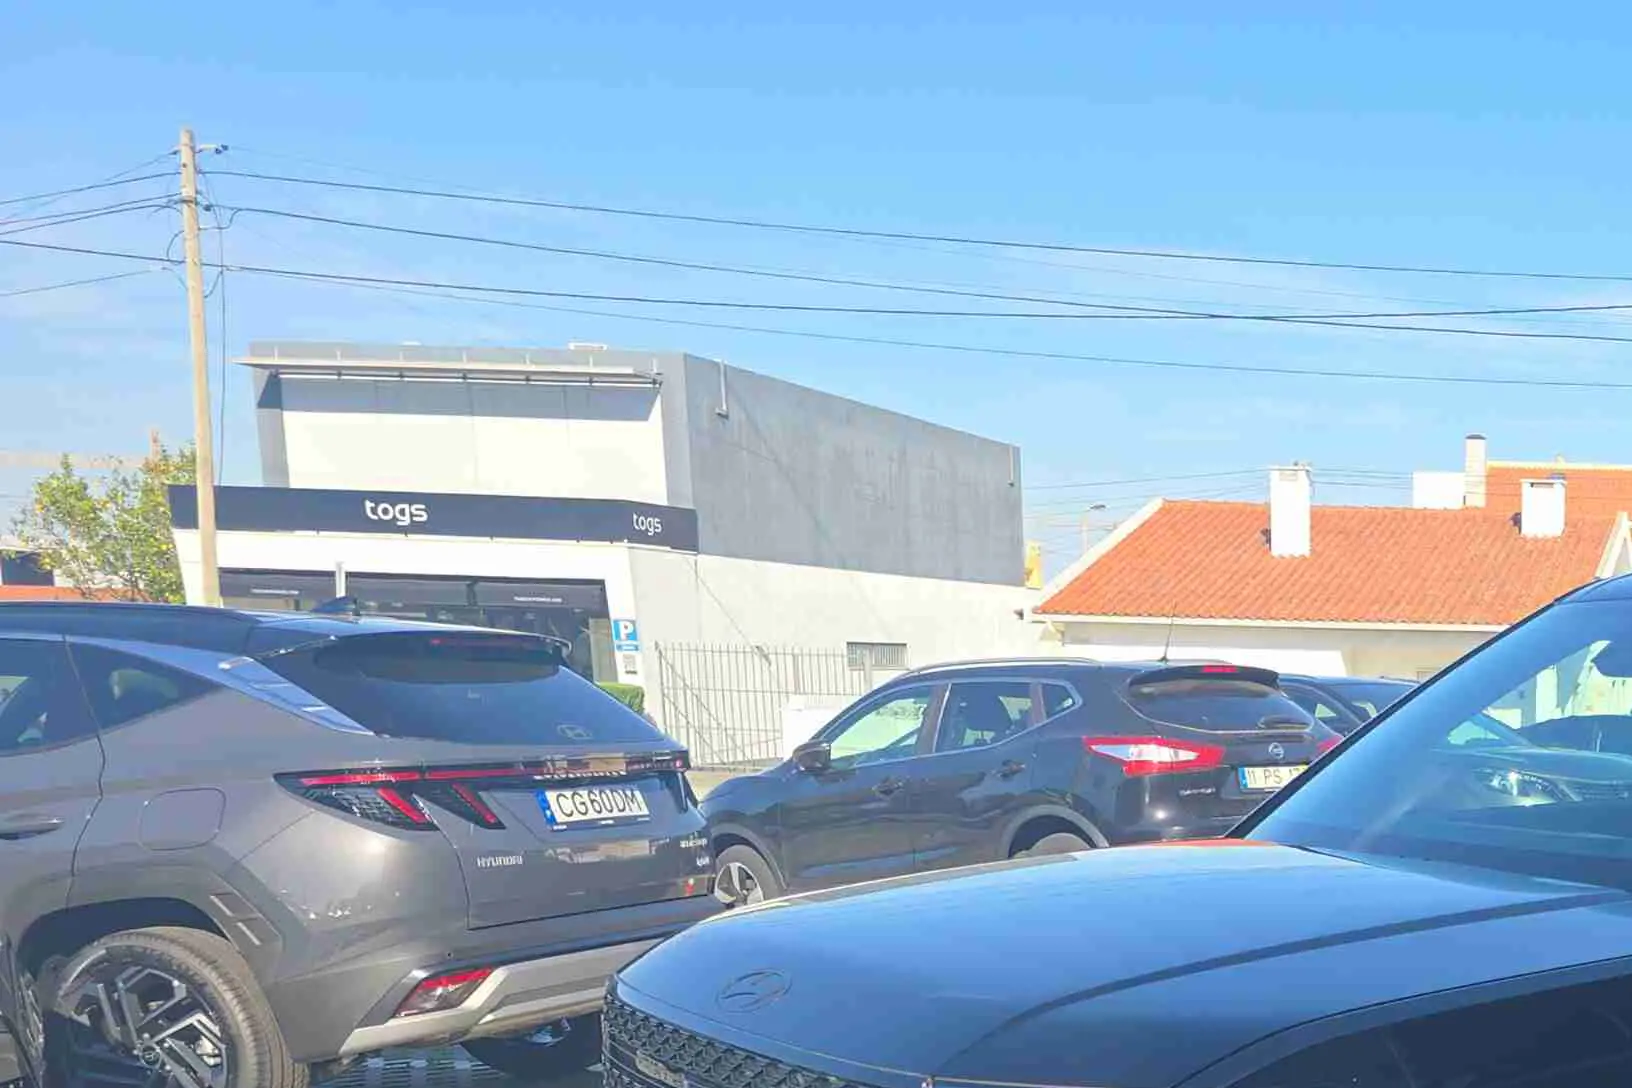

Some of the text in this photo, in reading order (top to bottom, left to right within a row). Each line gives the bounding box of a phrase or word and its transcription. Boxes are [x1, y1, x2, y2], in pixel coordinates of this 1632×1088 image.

[365, 499, 428, 525] togs
[633, 512, 662, 536] togs
[619, 620, 634, 640] P
[556, 789, 643, 818] CG60DM
